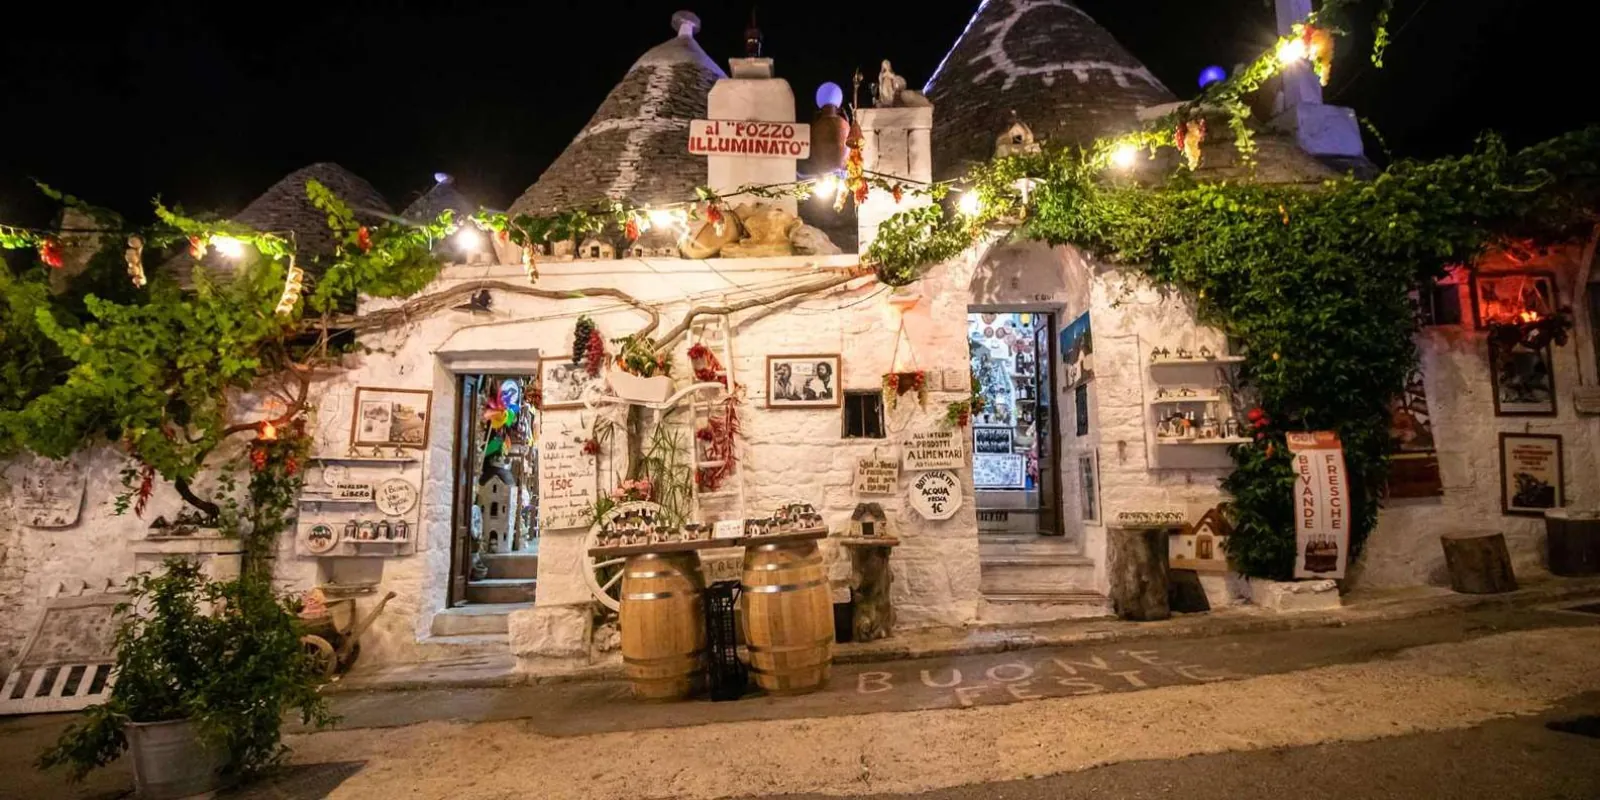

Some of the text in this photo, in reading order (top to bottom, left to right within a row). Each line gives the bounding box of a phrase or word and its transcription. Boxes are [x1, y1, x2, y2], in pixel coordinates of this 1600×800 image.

[705, 120, 795, 139] al "POZZO
[689, 137, 809, 155] ILLUMINATO"
[916, 440, 951, 448] PRODOTTI
[907, 448, 962, 460] ALIMENTARI
[915, 471, 956, 490] BOTTIGLIETTE
[341, 490, 370, 498] LIBERO
[922, 487, 950, 496] ACQUA
[1298, 455, 1315, 529] BEVANDE
[1325, 454, 1342, 530] FRESCHE
[931, 502, 944, 514] 1€
[857, 649, 1160, 694] BUONE
[954, 664, 1224, 706] FESTE
